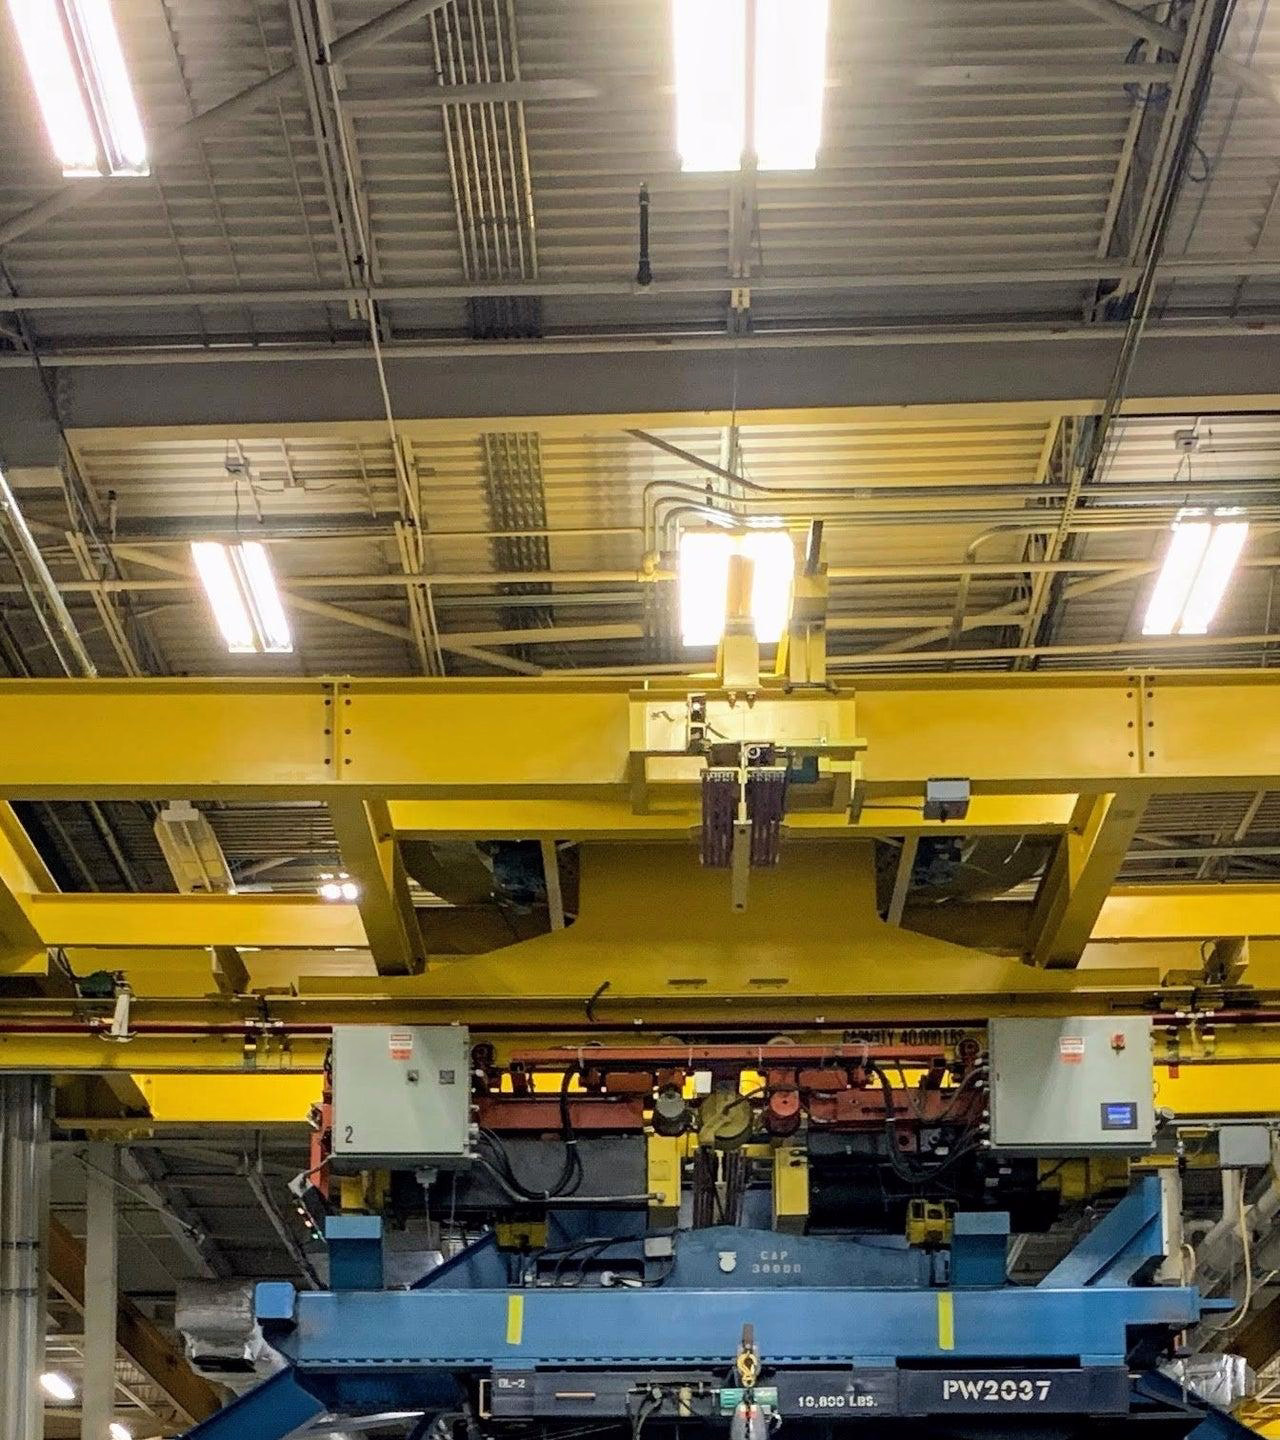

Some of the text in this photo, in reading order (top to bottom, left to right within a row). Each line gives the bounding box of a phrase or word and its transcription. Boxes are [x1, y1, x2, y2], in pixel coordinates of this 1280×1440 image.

[345, 1125, 353, 1143] 2
[760, 1250, 788, 1260] CAP
[943, 1379, 1052, 1401] PW2037
[798, 1396, 878, 1408] 10,800 LBS.
